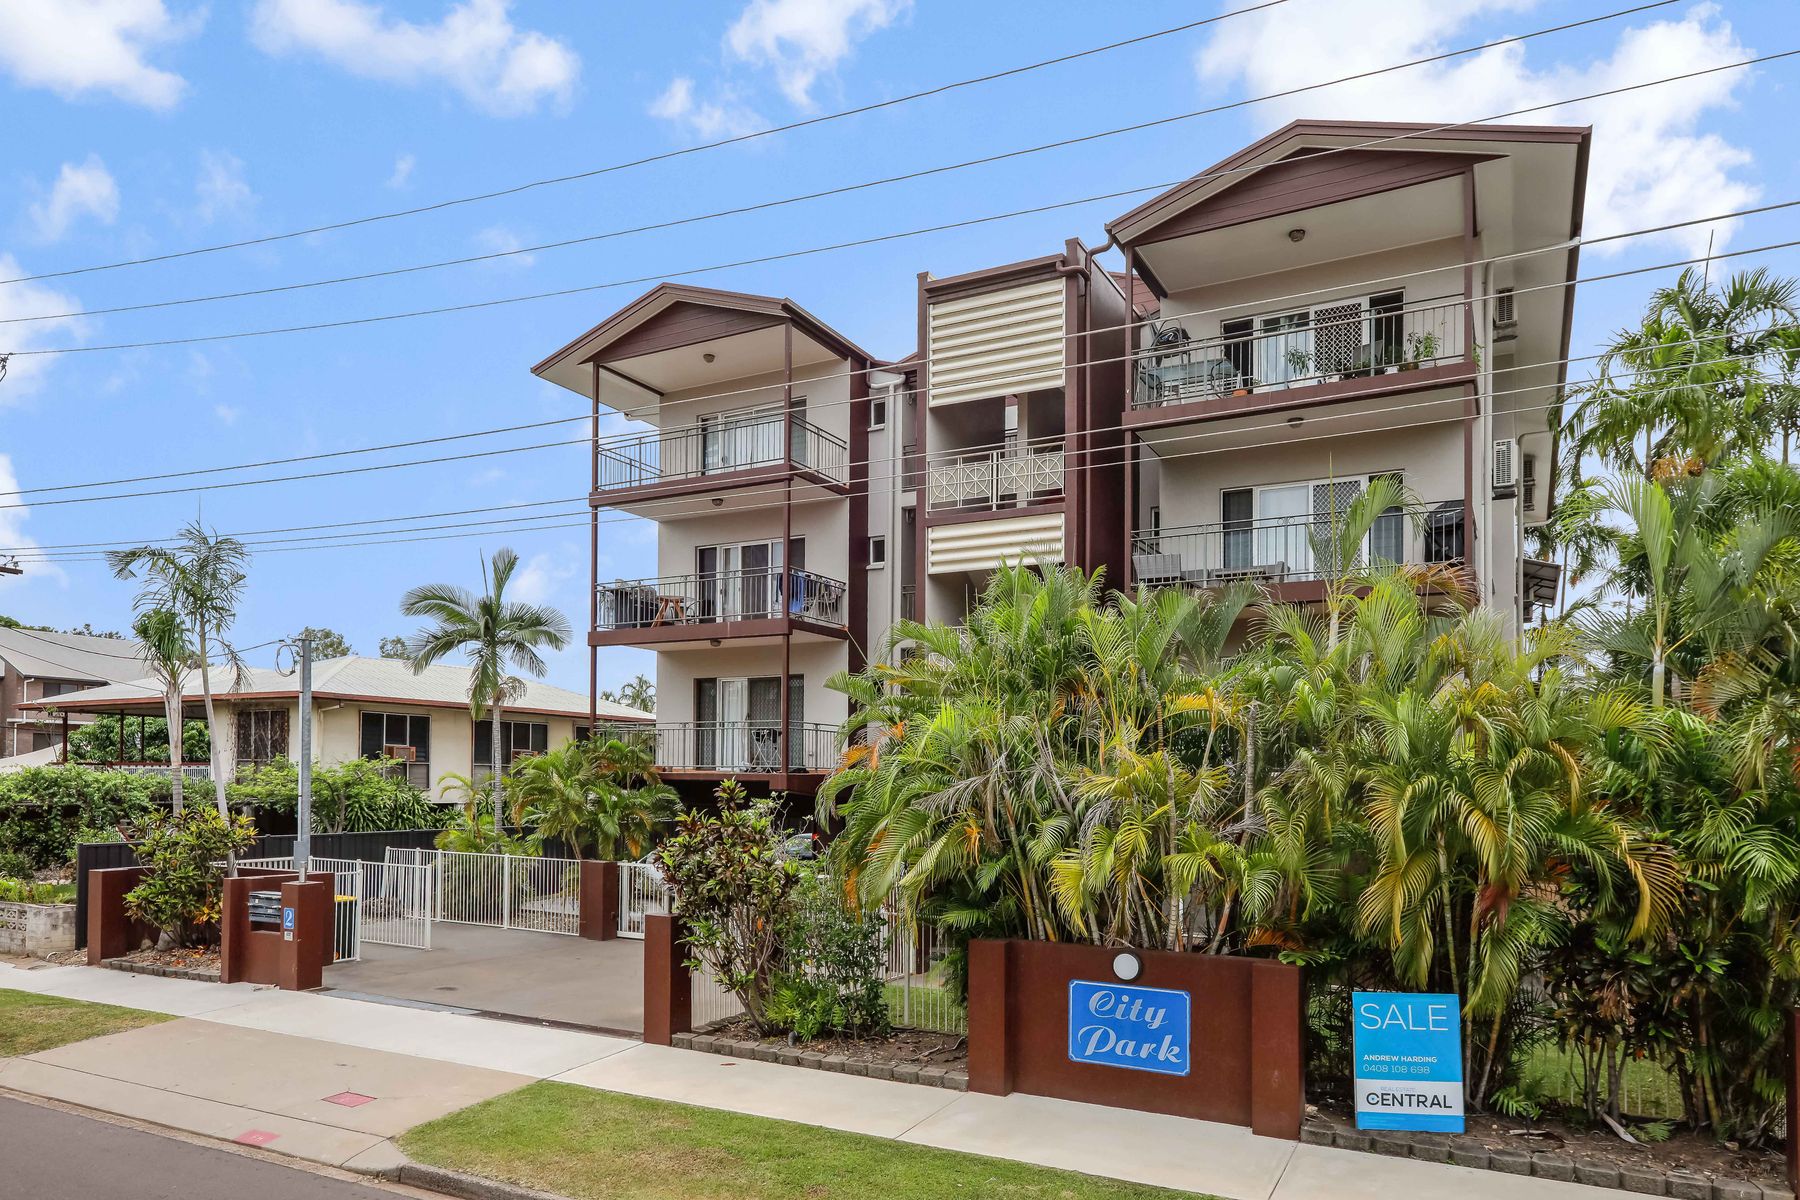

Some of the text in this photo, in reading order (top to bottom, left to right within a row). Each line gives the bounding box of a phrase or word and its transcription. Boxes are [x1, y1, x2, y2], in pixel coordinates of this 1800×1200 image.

[285, 910, 293, 926] 2
[1088, 990, 1169, 1030] City
[1360, 1003, 1449, 1031] SALE
[1077, 1025, 1183, 1063] Park
[1363, 1054, 1438, 1063] ANDREW HARDING
[1363, 1064, 1389, 1072] 0408
[1410, 1066, 1431, 1074] 698
[1366, 1092, 1453, 1109] CENTRAL
